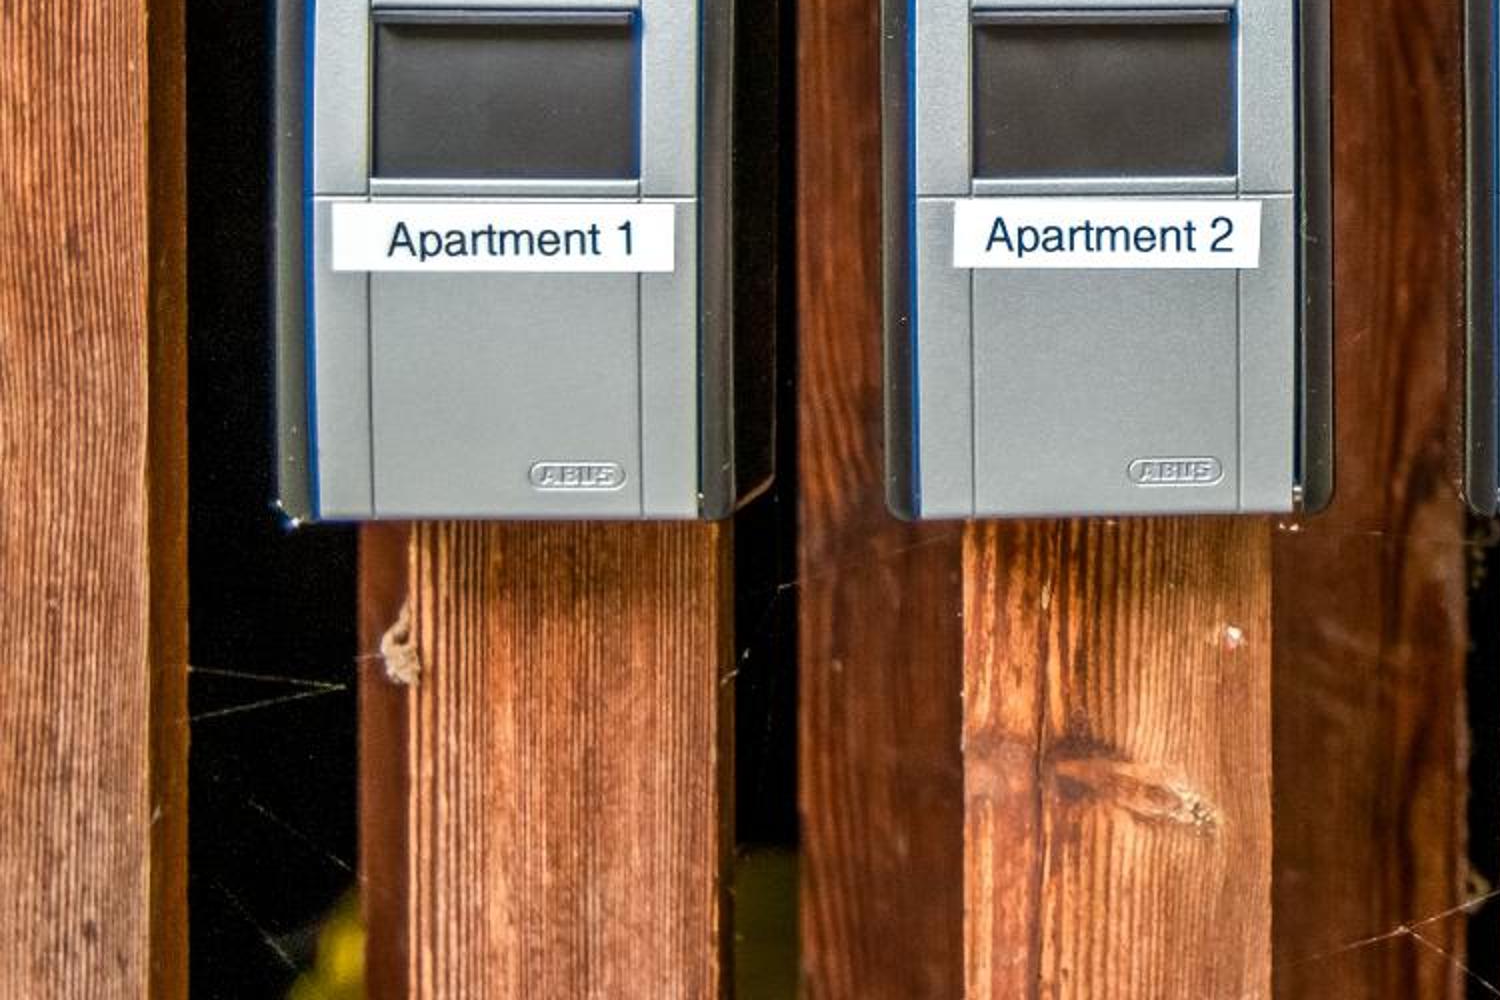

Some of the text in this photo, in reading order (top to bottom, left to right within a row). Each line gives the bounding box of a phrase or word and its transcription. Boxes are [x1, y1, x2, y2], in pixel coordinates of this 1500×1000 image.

[387, 220, 632, 263] Apartment 1
[985, 216, 1233, 259] Apartment 2
[539, 464, 615, 486] ABUS
[1140, 461, 1214, 482] ABUS
